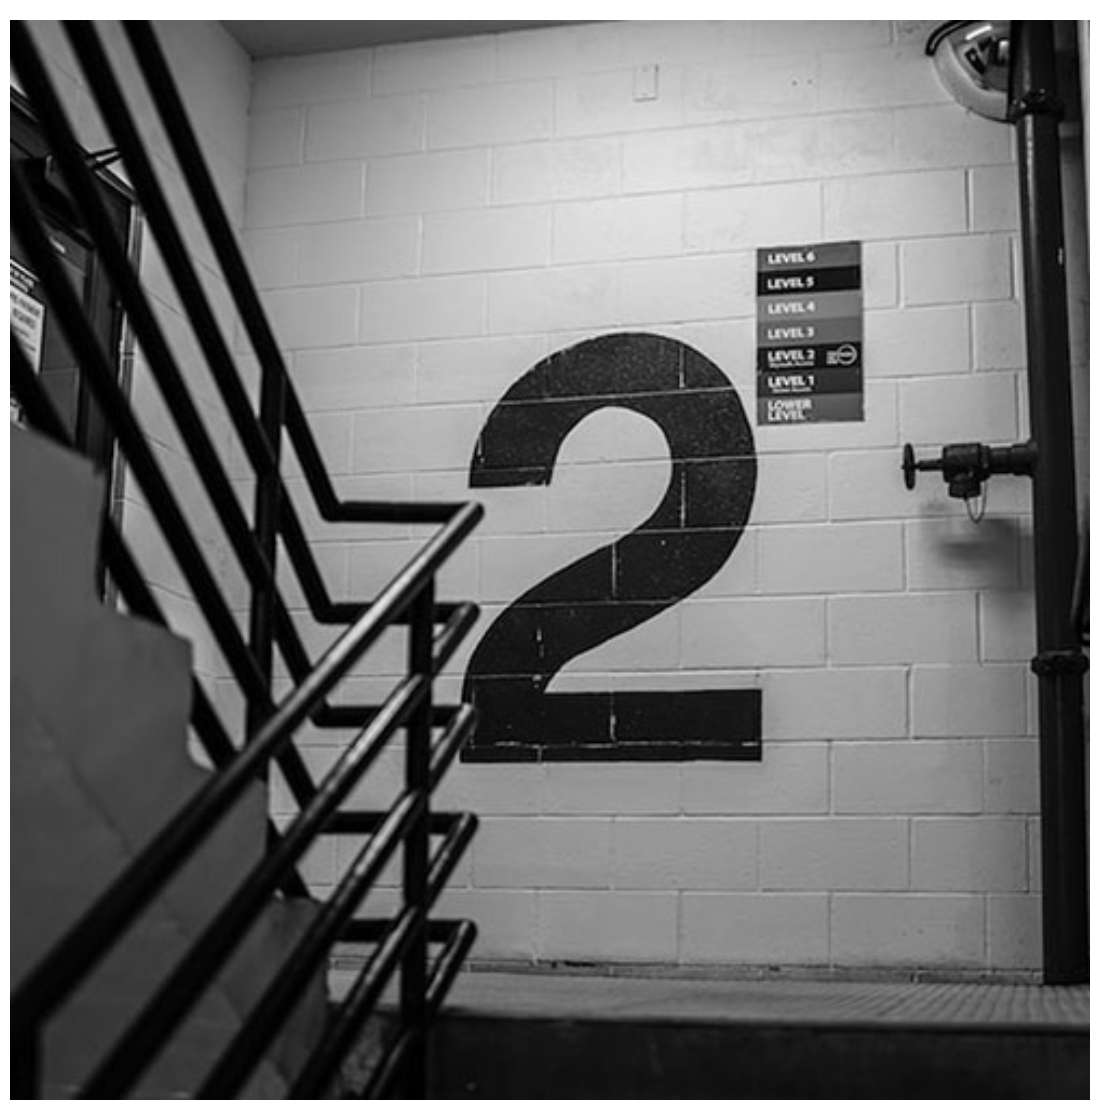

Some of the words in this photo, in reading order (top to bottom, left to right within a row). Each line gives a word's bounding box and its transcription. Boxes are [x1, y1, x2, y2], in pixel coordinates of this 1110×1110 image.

[768, 252, 804, 265] LEVEL
[806, 251, 816, 263] 6
[767, 277, 804, 290] LEVEL
[806, 276, 815, 288] 5
[767, 302, 804, 314] LEVEL
[806, 300, 815, 312] 4
[767, 327, 804, 340] LEVEL
[806, 326, 815, 338] 3
[768, 350, 804, 362] LEVEL
[806, 349, 815, 360] 2
[768, 376, 804, 388] LEVEL
[767, 399, 812, 411] LOWER
[767, 410, 804, 421] LEVEL
[461, 332, 762, 763] 2
